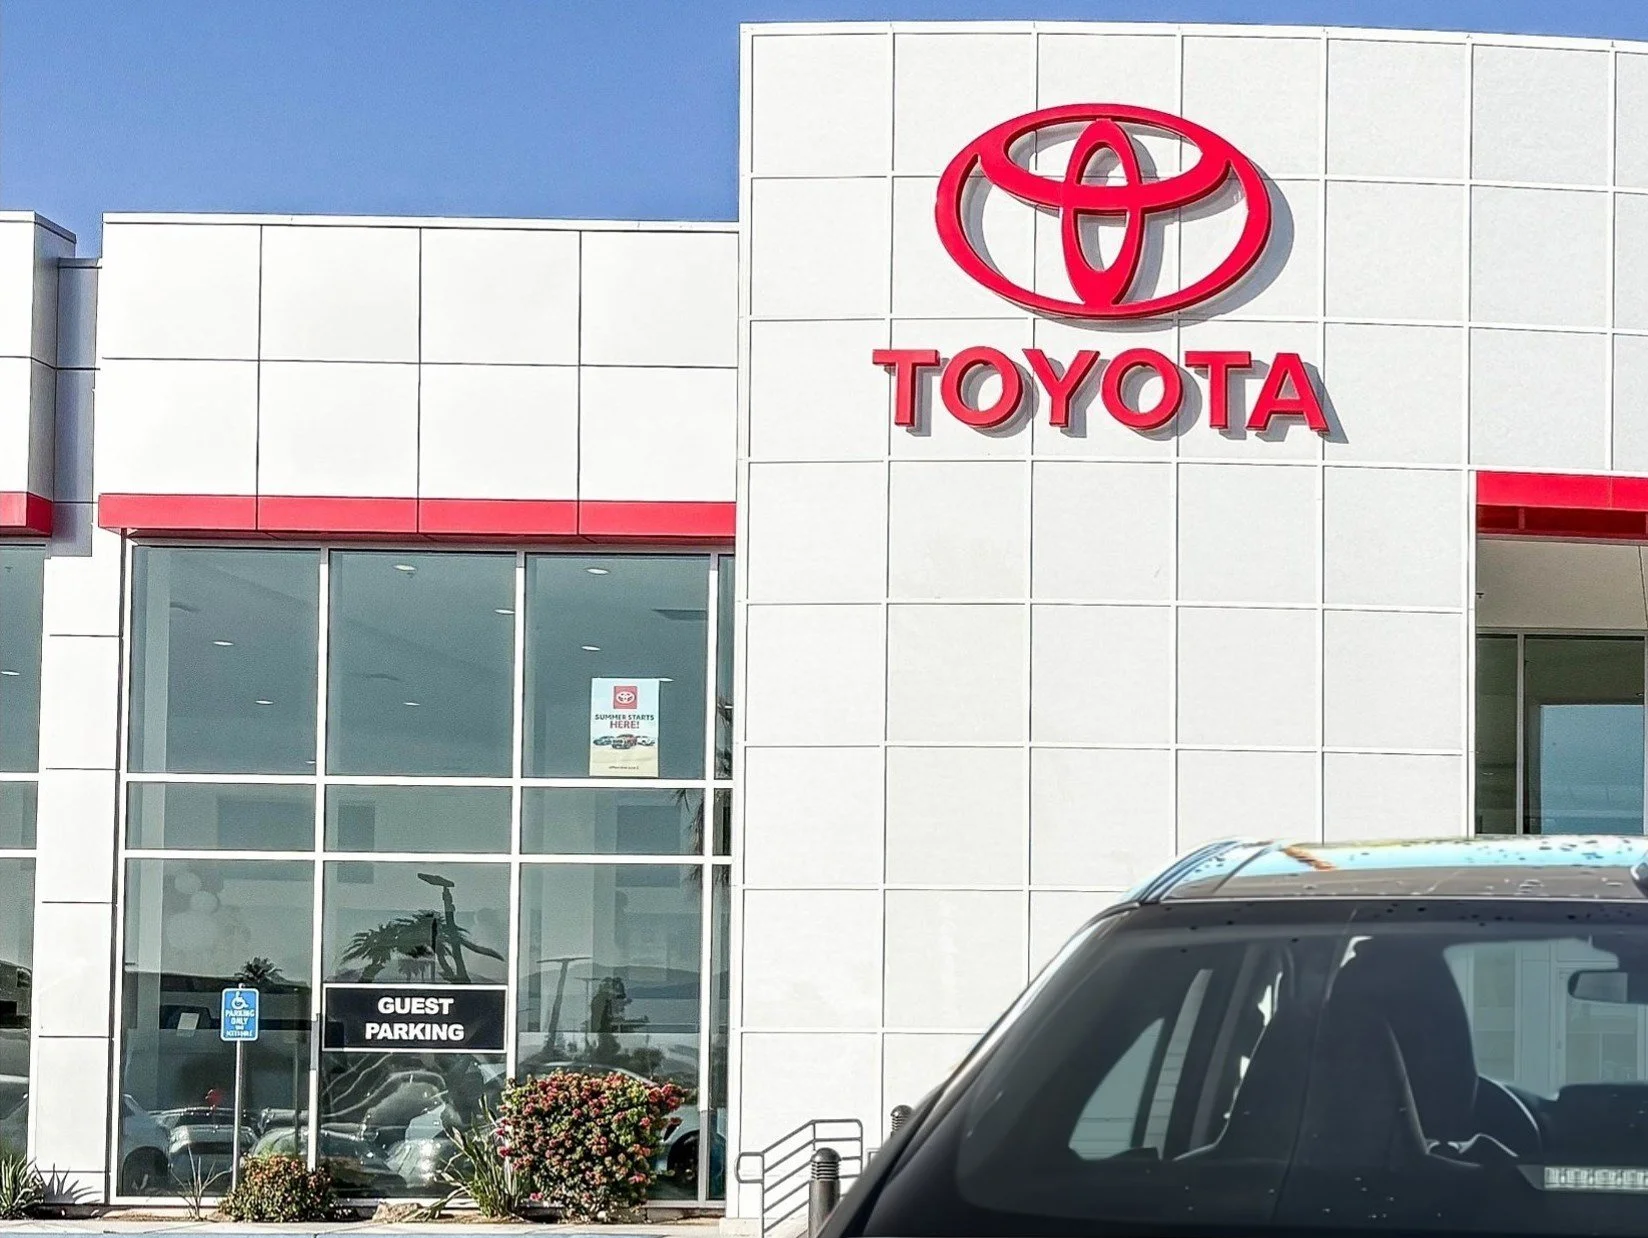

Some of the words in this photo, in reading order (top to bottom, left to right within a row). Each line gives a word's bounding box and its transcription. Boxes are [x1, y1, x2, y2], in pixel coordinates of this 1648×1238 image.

[872, 346, 1330, 434] TOYOTA
[609, 721, 640, 729] HERE!
[377, 997, 454, 1015] GUEST
[365, 1022, 465, 1041] PARKING
